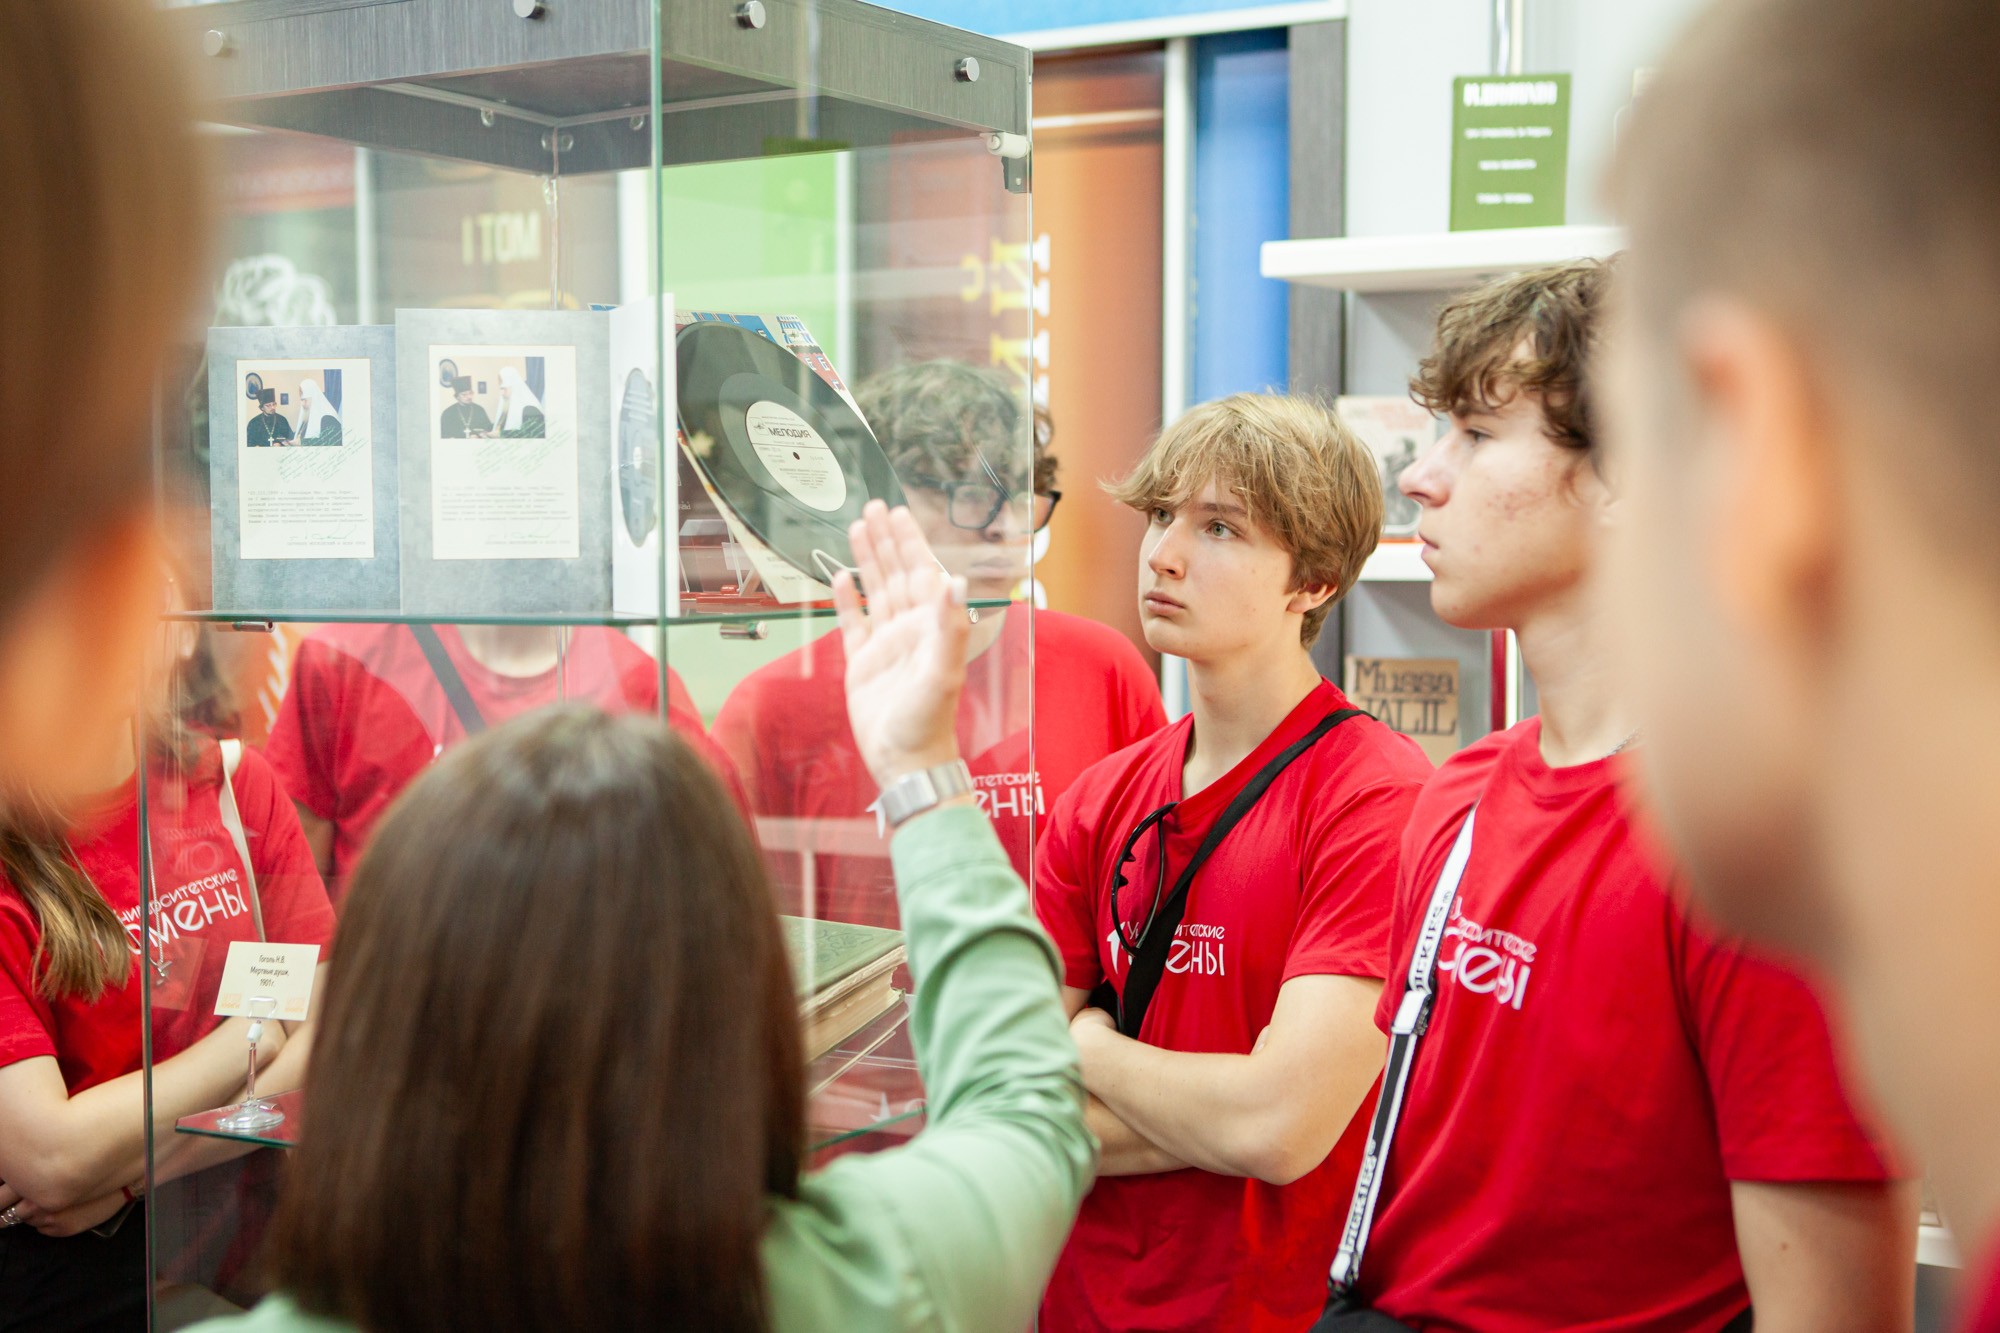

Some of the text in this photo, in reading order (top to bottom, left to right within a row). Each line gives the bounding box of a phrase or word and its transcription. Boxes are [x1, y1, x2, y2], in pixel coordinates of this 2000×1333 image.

[768, 428, 812, 438] МЕЛОДИЯ
[974, 786, 1046, 818] ены
[259, 954, 275, 963] Гоголь
